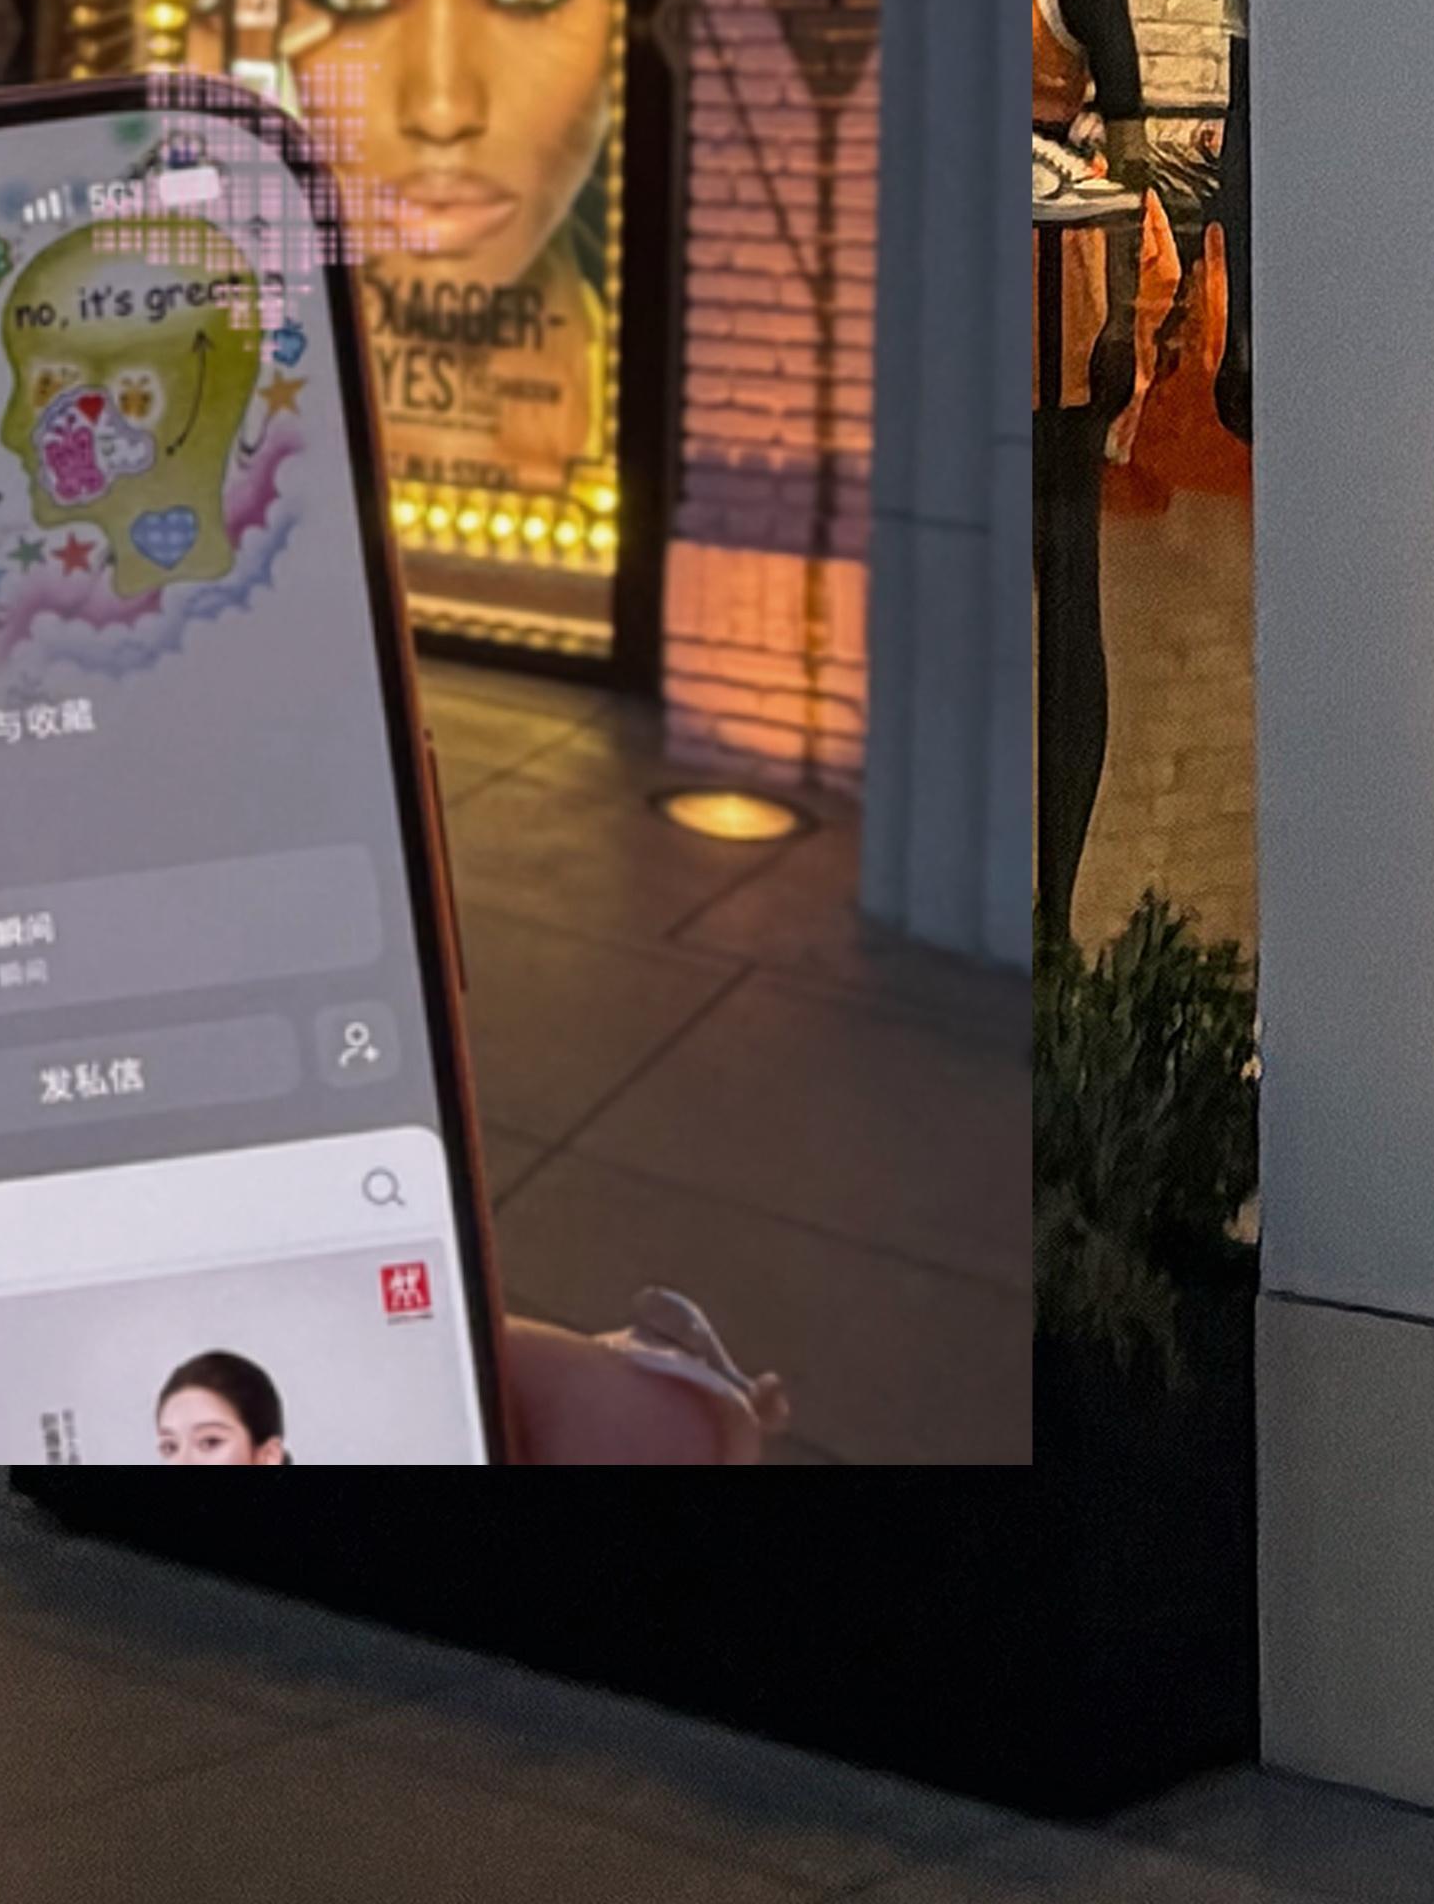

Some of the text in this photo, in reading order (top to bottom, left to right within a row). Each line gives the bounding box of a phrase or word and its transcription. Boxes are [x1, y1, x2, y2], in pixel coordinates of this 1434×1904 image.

[79, 287, 134, 320] it's
[144, 273, 243, 323] great
[38, 1057, 145, 1105] 发私信
